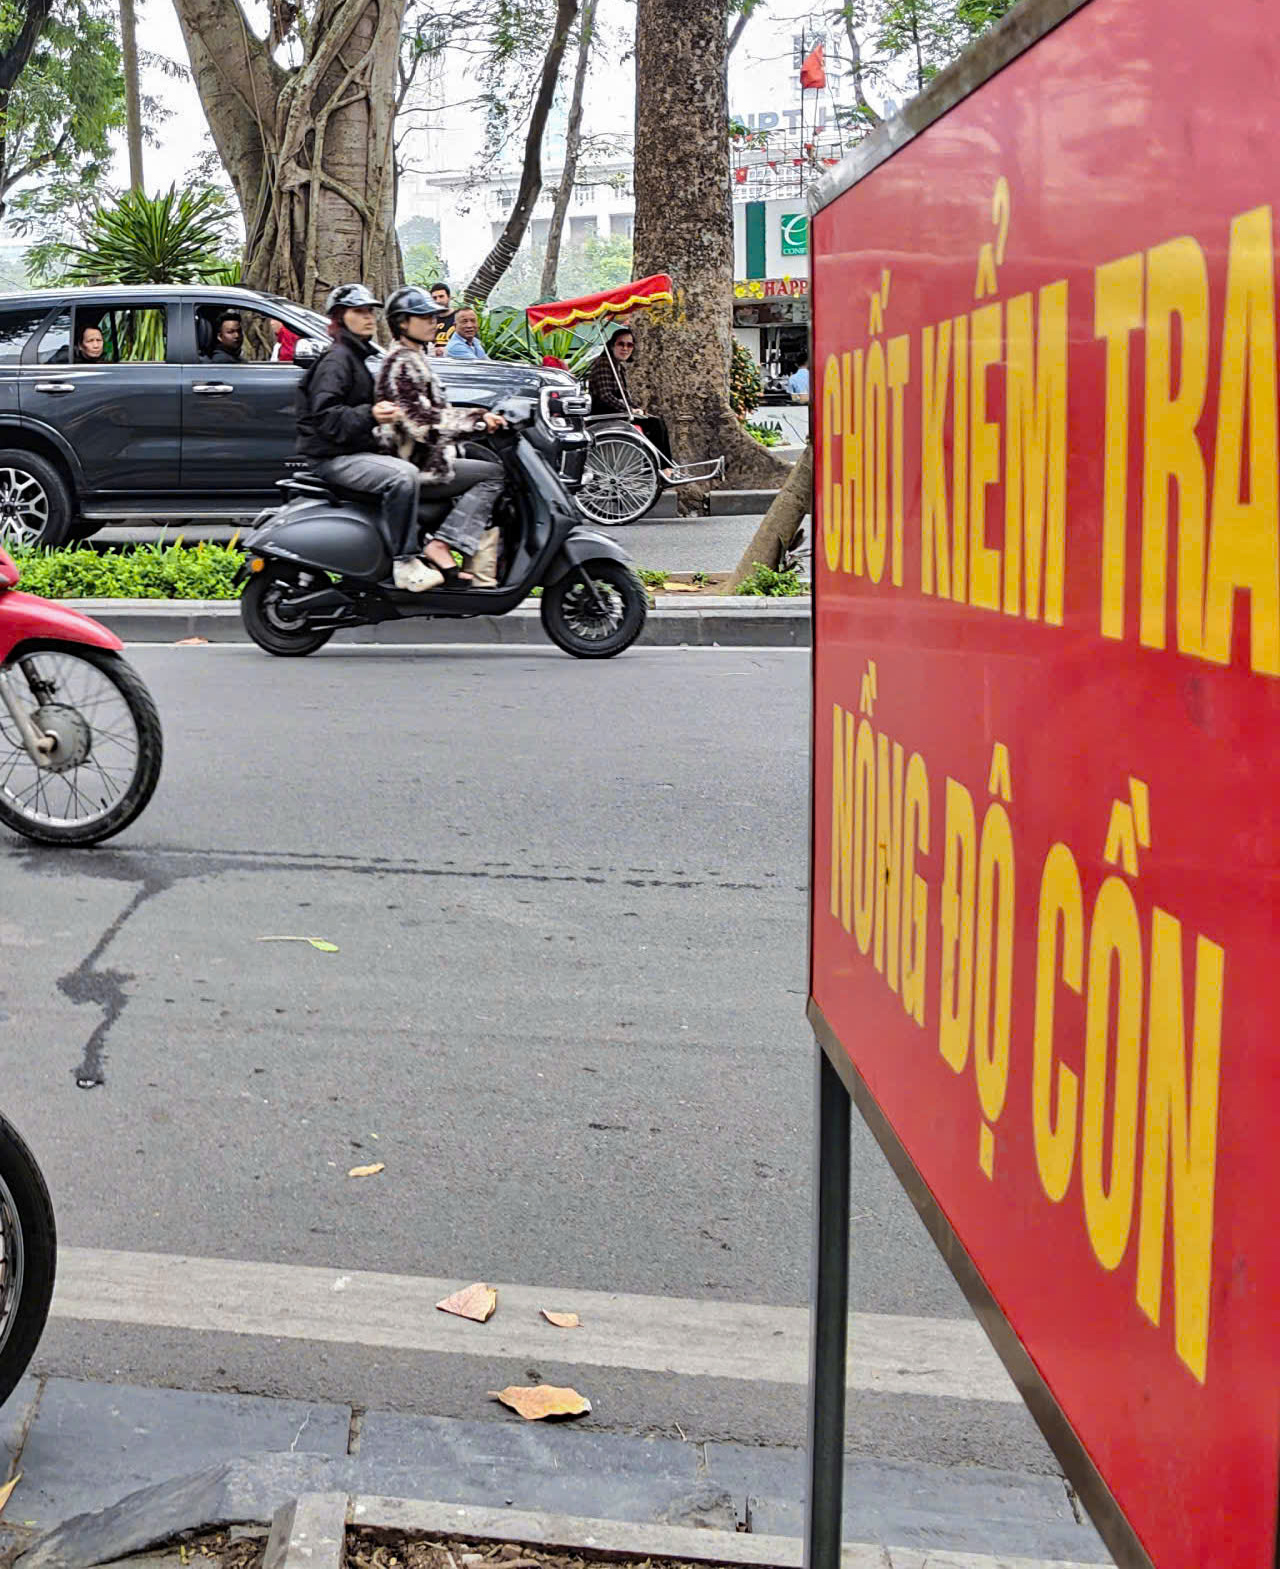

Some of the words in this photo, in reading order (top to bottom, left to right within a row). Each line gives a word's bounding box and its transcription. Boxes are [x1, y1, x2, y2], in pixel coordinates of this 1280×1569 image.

[764, 280, 808, 296] HAPP
[822, 269, 910, 588] CHỐT
[921, 176, 1068, 627] KIỂM
[1094, 204, 1280, 678] TRA
[830, 659, 930, 1028] NỒNG
[939, 741, 1016, 1182] ĐỘ
[1032, 777, 1225, 1385] CỒN
